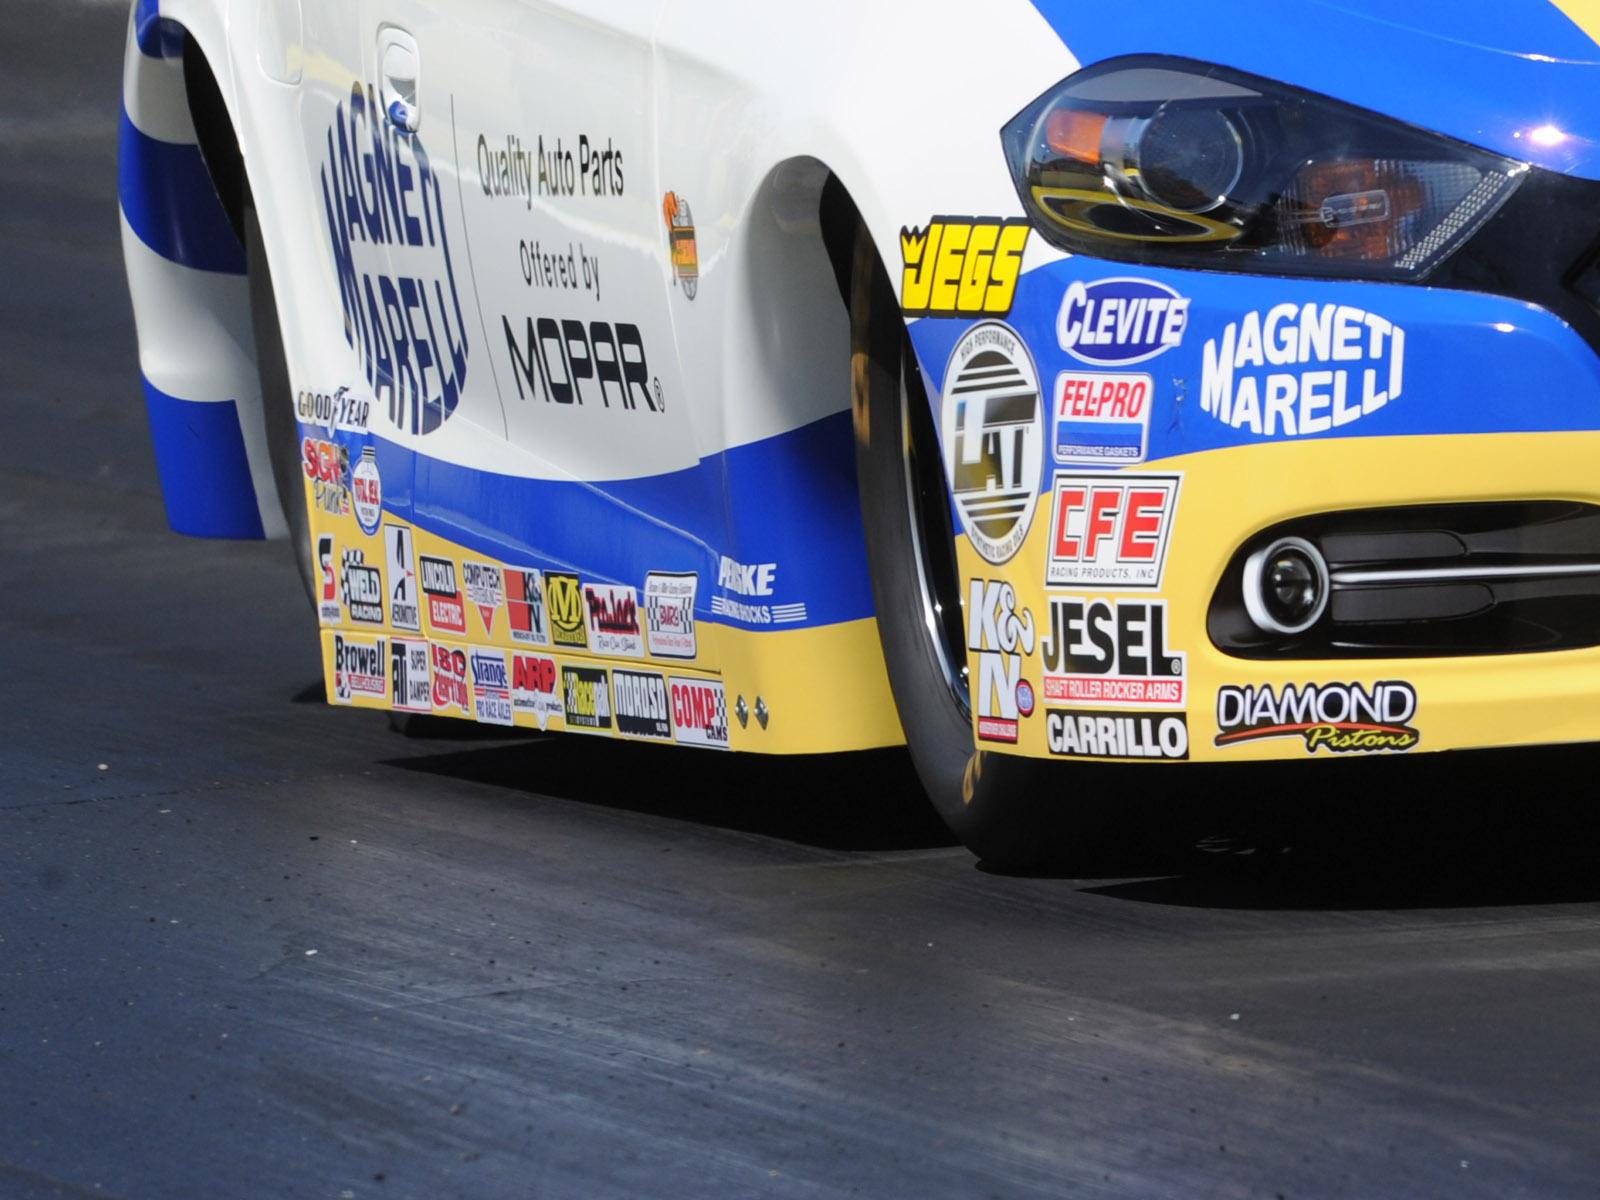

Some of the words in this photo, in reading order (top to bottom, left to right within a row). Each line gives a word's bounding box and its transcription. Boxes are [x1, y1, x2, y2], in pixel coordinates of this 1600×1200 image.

[477, 133, 532, 210] Quality
[538, 134, 575, 196] Auto
[578, 134, 624, 197] Parts
[519, 239, 578, 289] Offered
[580, 243, 601, 301] by
[901, 220, 1030, 312] JEGS
[1060, 281, 1191, 349] CLEVITE
[1201, 302, 1405, 368] MAGNETI
[502, 314, 657, 412] MOPAR
[1060, 379, 1146, 418] FEL-PRO
[1201, 368, 1405, 436] MARELLI
[1104, 446, 1139, 457] GASKETS
[1053, 490, 1172, 561] CFE
[348, 566, 380, 604] WELD
[1050, 566, 1079, 578] RACING
[1136, 568, 1155, 579] INC
[432, 600, 463, 626] ELECTRIC
[335, 634, 385, 677] Browell
[1042, 601, 1182, 676] JESEL
[470, 649, 509, 689] Strange
[513, 655, 557, 694] ARP
[1045, 678, 1068, 698] SHAFT
[1069, 679, 1102, 699] ROLLER
[1103, 680, 1145, 700] ROCKER
[1147, 681, 1180, 701] ARMS
[671, 684, 715, 730] COMP
[1218, 684, 1415, 727] DIAMOND
[706, 725, 728, 742] CAMS
[1047, 713, 1188, 758] CARRILLO
[1305, 723, 1416, 748] Pistons
